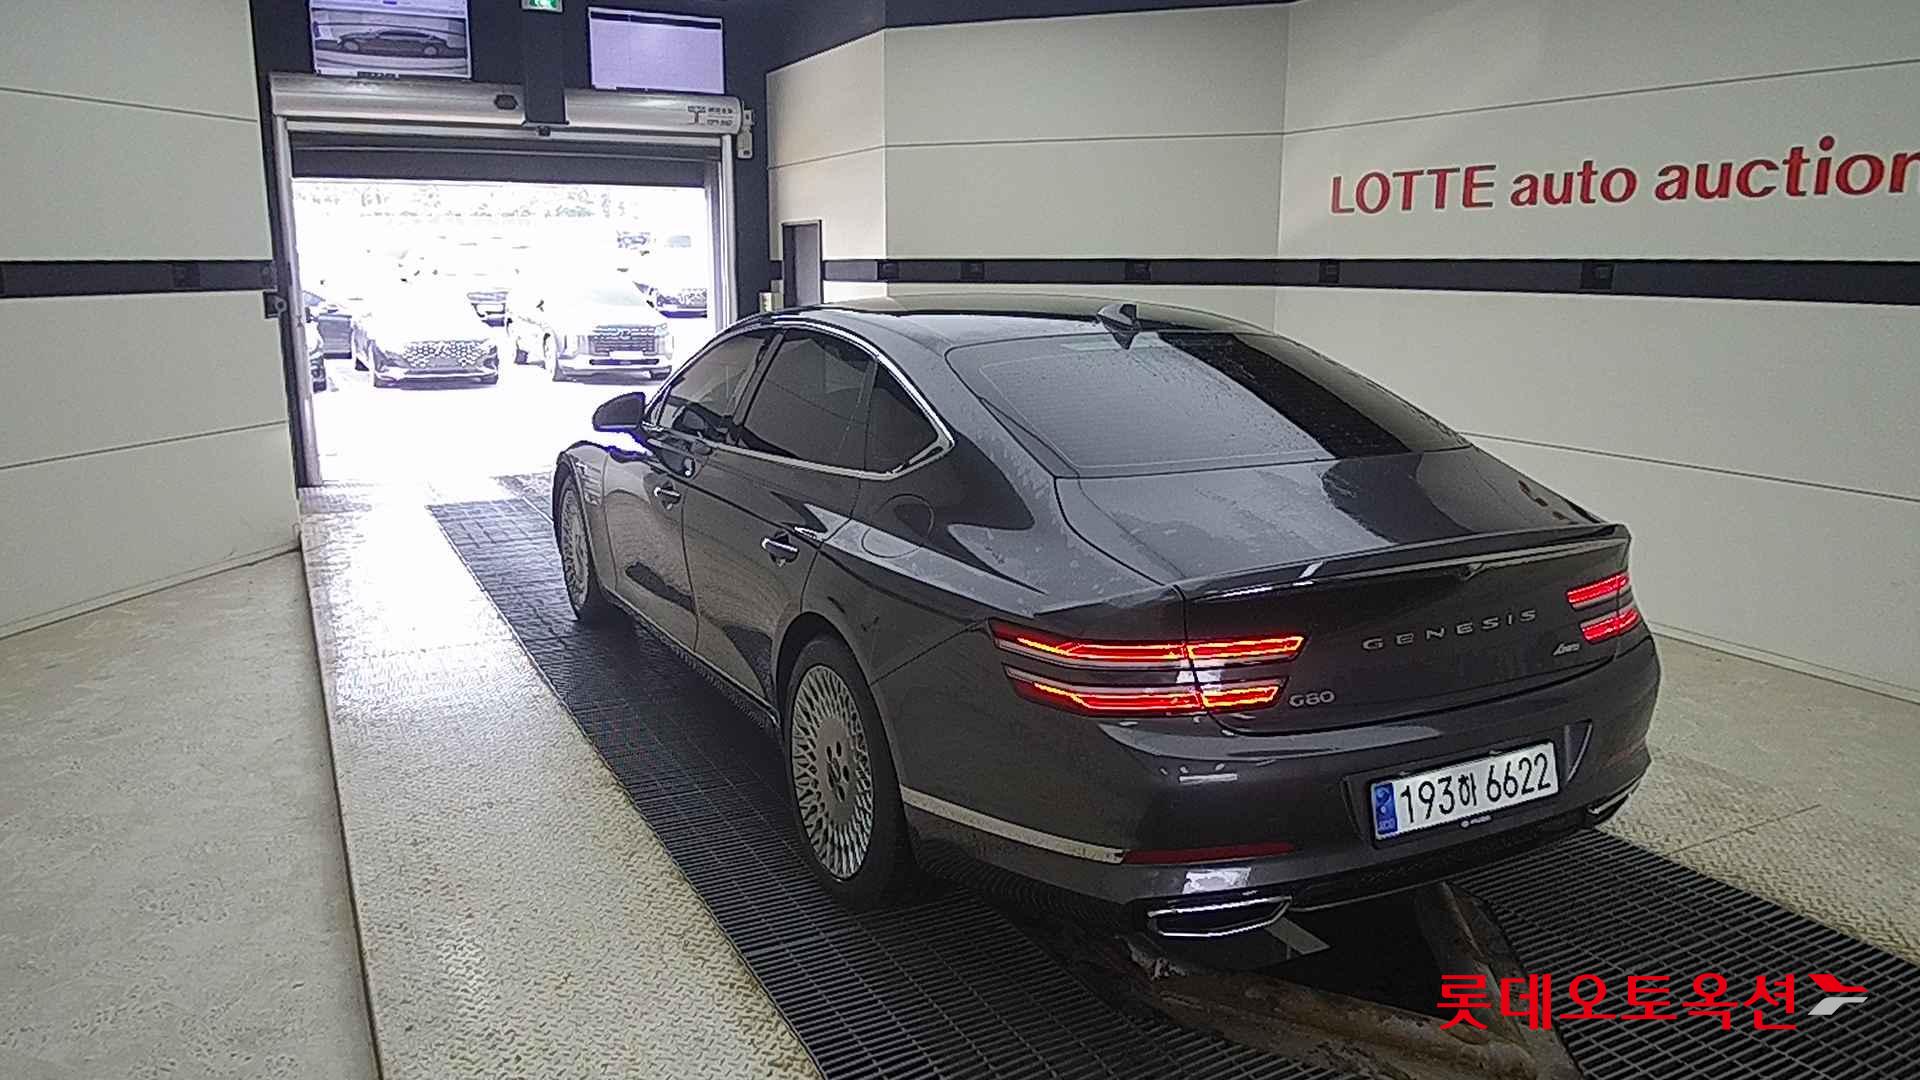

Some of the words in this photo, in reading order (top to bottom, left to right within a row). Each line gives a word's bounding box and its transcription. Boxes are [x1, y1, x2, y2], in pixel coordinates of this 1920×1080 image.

[1331, 165, 1496, 213] LOTTE
[1511, 160, 1638, 206] auto
[1361, 608, 1538, 651] GENESIS
[1288, 690, 1336, 708] G80
[1400, 772, 1478, 824] 193하
[1486, 752, 1552, 803] 6622
